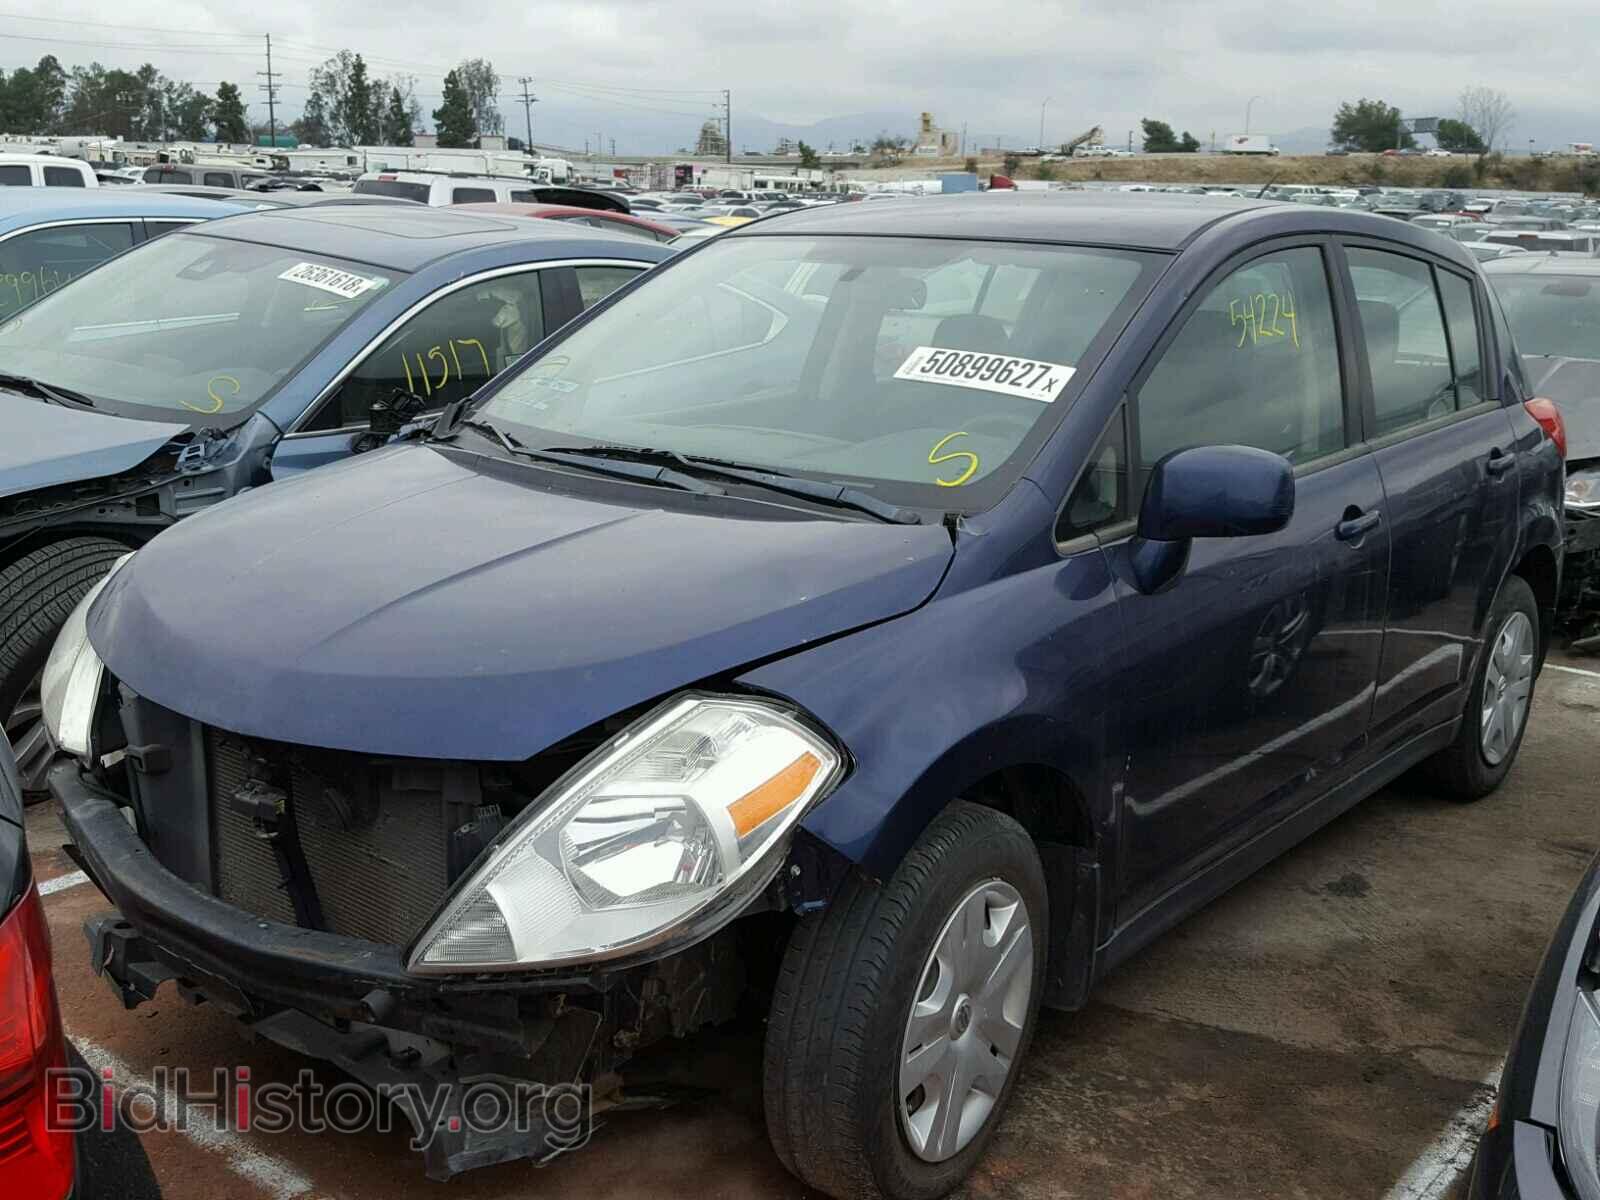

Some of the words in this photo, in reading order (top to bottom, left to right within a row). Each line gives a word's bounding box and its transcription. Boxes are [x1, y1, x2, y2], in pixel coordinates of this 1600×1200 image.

[920, 350, 1053, 389] 50899627
[179, 376, 240, 414] S
[928, 431, 978, 487] S
